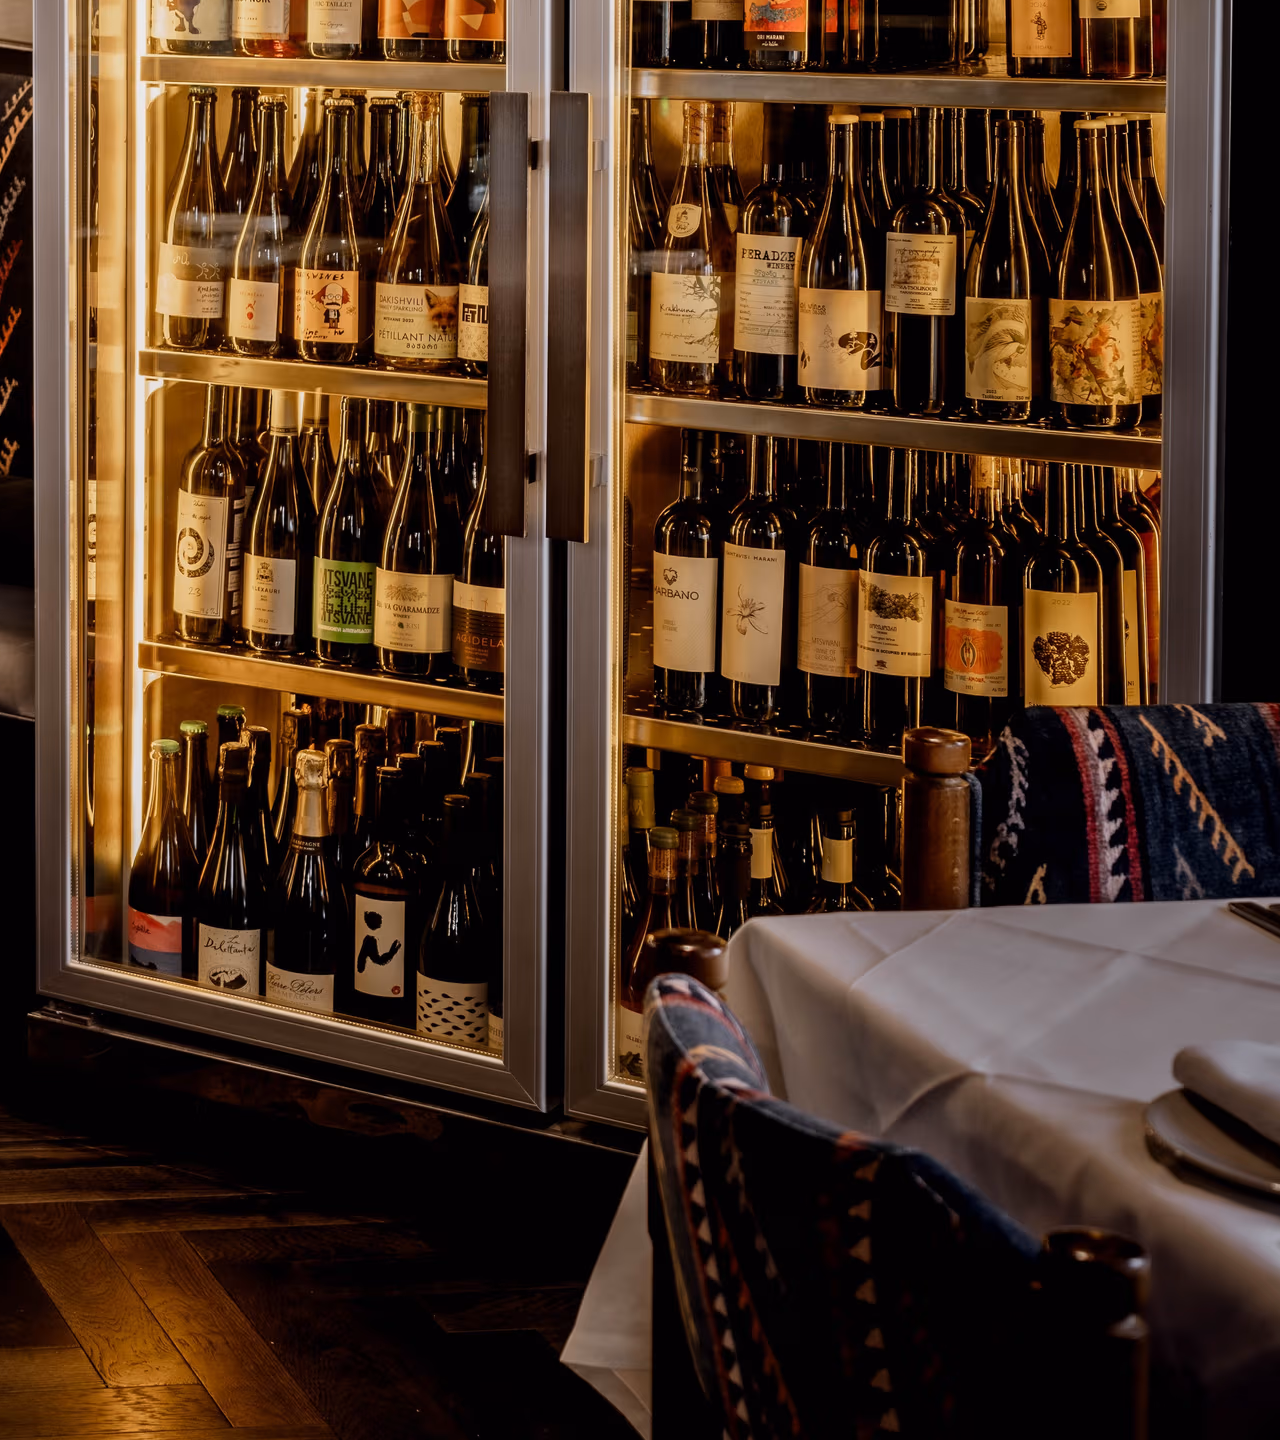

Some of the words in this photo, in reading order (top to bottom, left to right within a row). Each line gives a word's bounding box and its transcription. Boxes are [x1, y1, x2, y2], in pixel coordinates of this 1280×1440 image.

[741, 247, 796, 262] PERADZE
[766, 261, 795, 270] WINERY
[379, 294, 424, 306] DAKISHVILI
[393, 305, 424, 313] SPARKLING
[379, 327, 424, 342] PÉTILLANT
[252, 585, 281, 594] LEXAURI
[392, 603, 441, 615] GVARAMADZE
[203, 936, 256, 955] Dilettante
